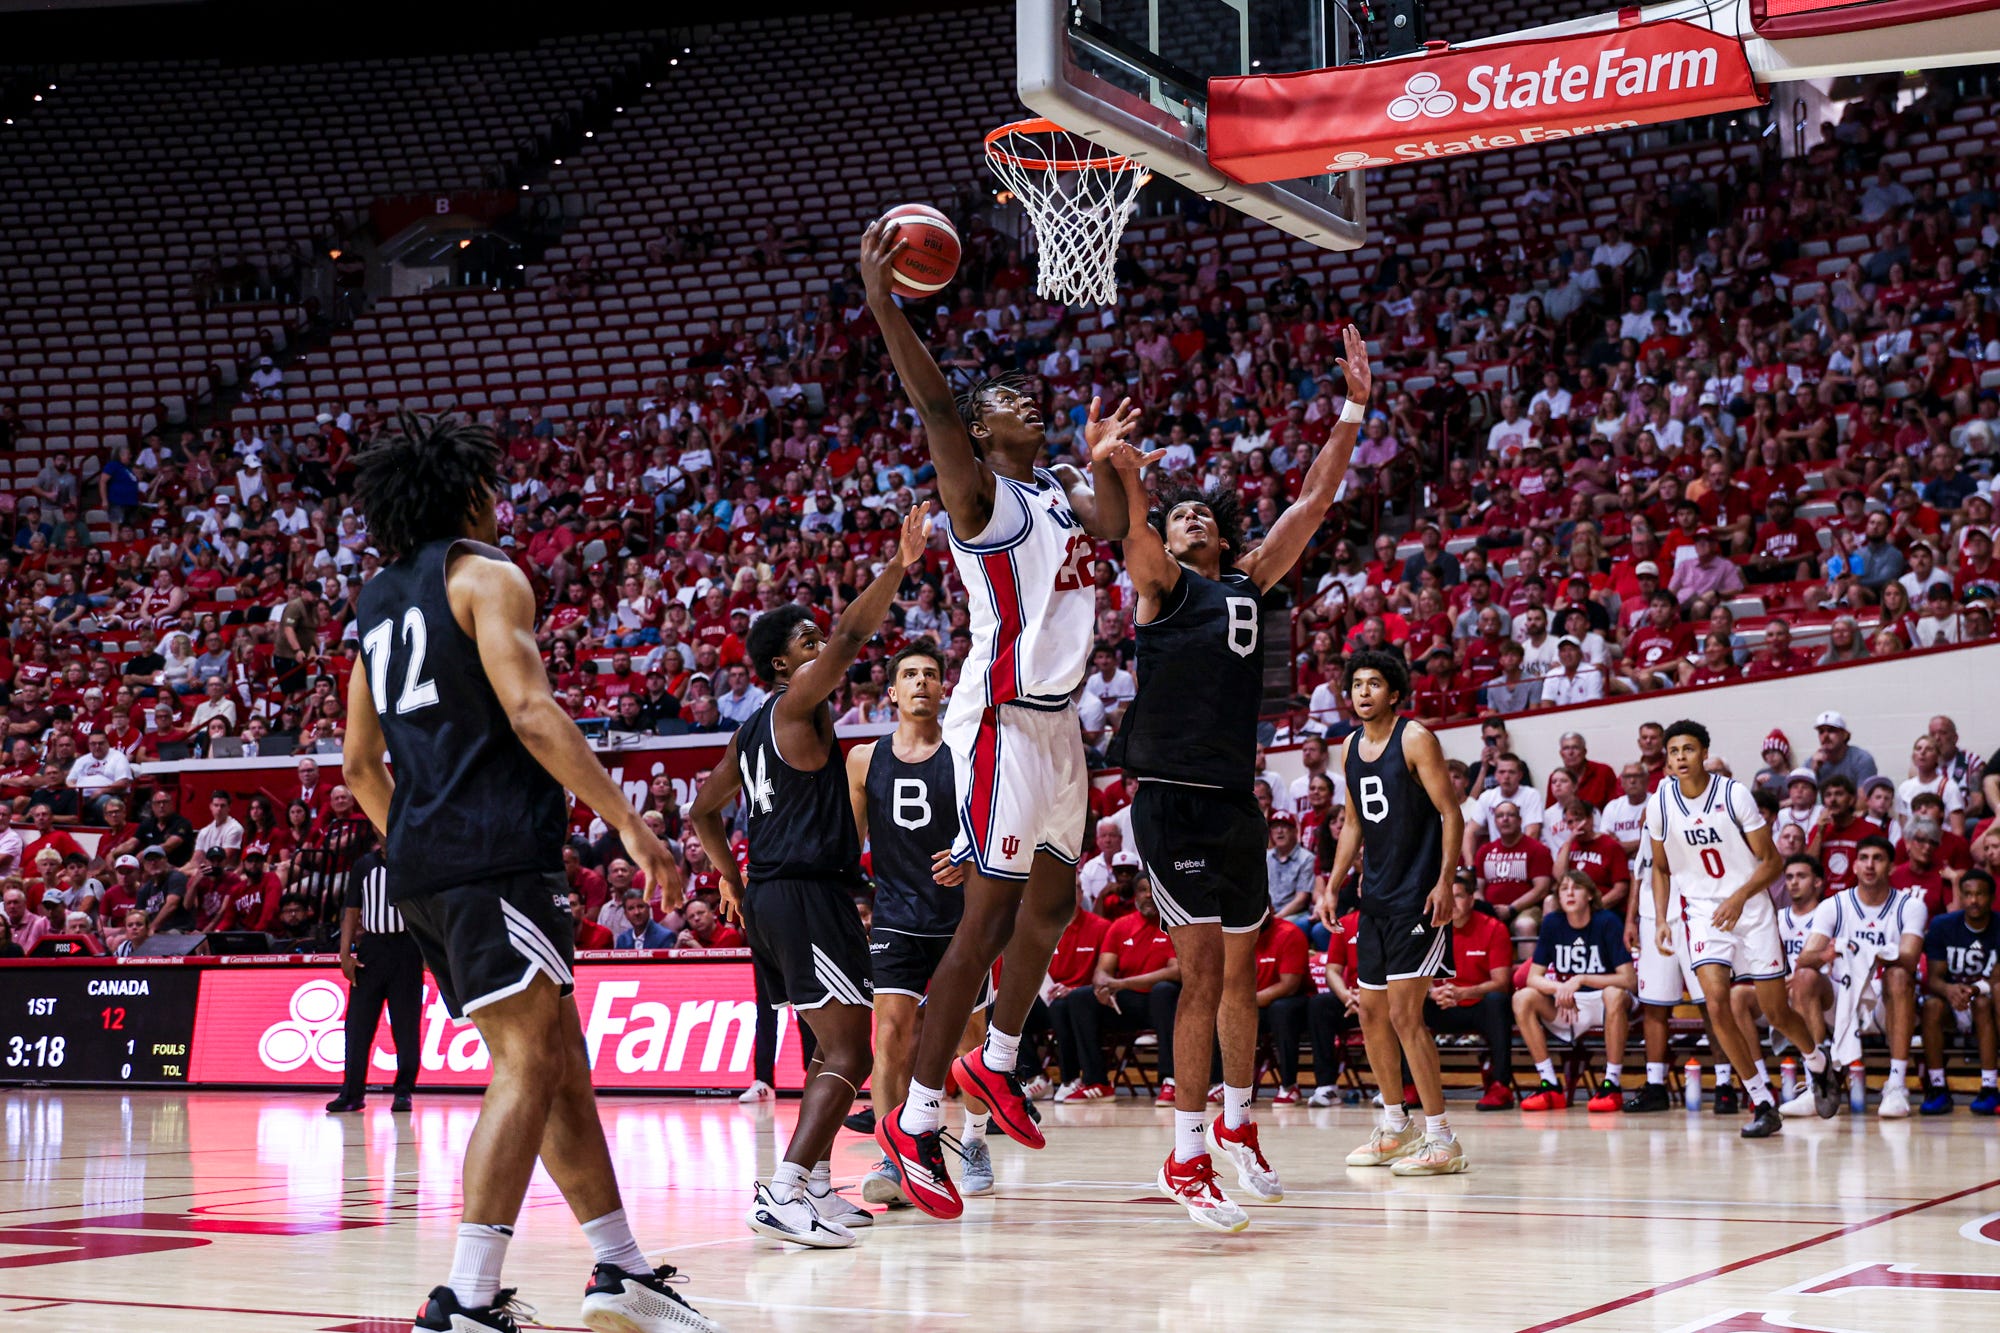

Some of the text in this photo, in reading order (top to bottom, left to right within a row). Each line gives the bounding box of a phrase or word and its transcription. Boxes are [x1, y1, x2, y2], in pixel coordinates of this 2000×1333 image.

[436, 199, 449, 214] B
[1054, 534, 1096, 592] 22
[1225, 596, 1259, 658] B
[892, 778, 932, 831] B
[1359, 775, 1389, 824] B
[1684, 827, 1723, 846] USA
[1700, 848, 1726, 879] 0
[55, 943, 71, 953] POSS
[1555, 944, 1606, 973] USA
[1785, 940, 1804, 954] US
[1946, 946, 1998, 977] USA
[88, 980, 149, 996] CANADA
[27, 998, 57, 1015] 1ST
[102, 1007, 126, 1030] 12
[6, 1036, 66, 1067] 3:18
[127, 1040, 186, 1056] 1 FOULS
[121, 1064, 182, 1080] 0 TOL
